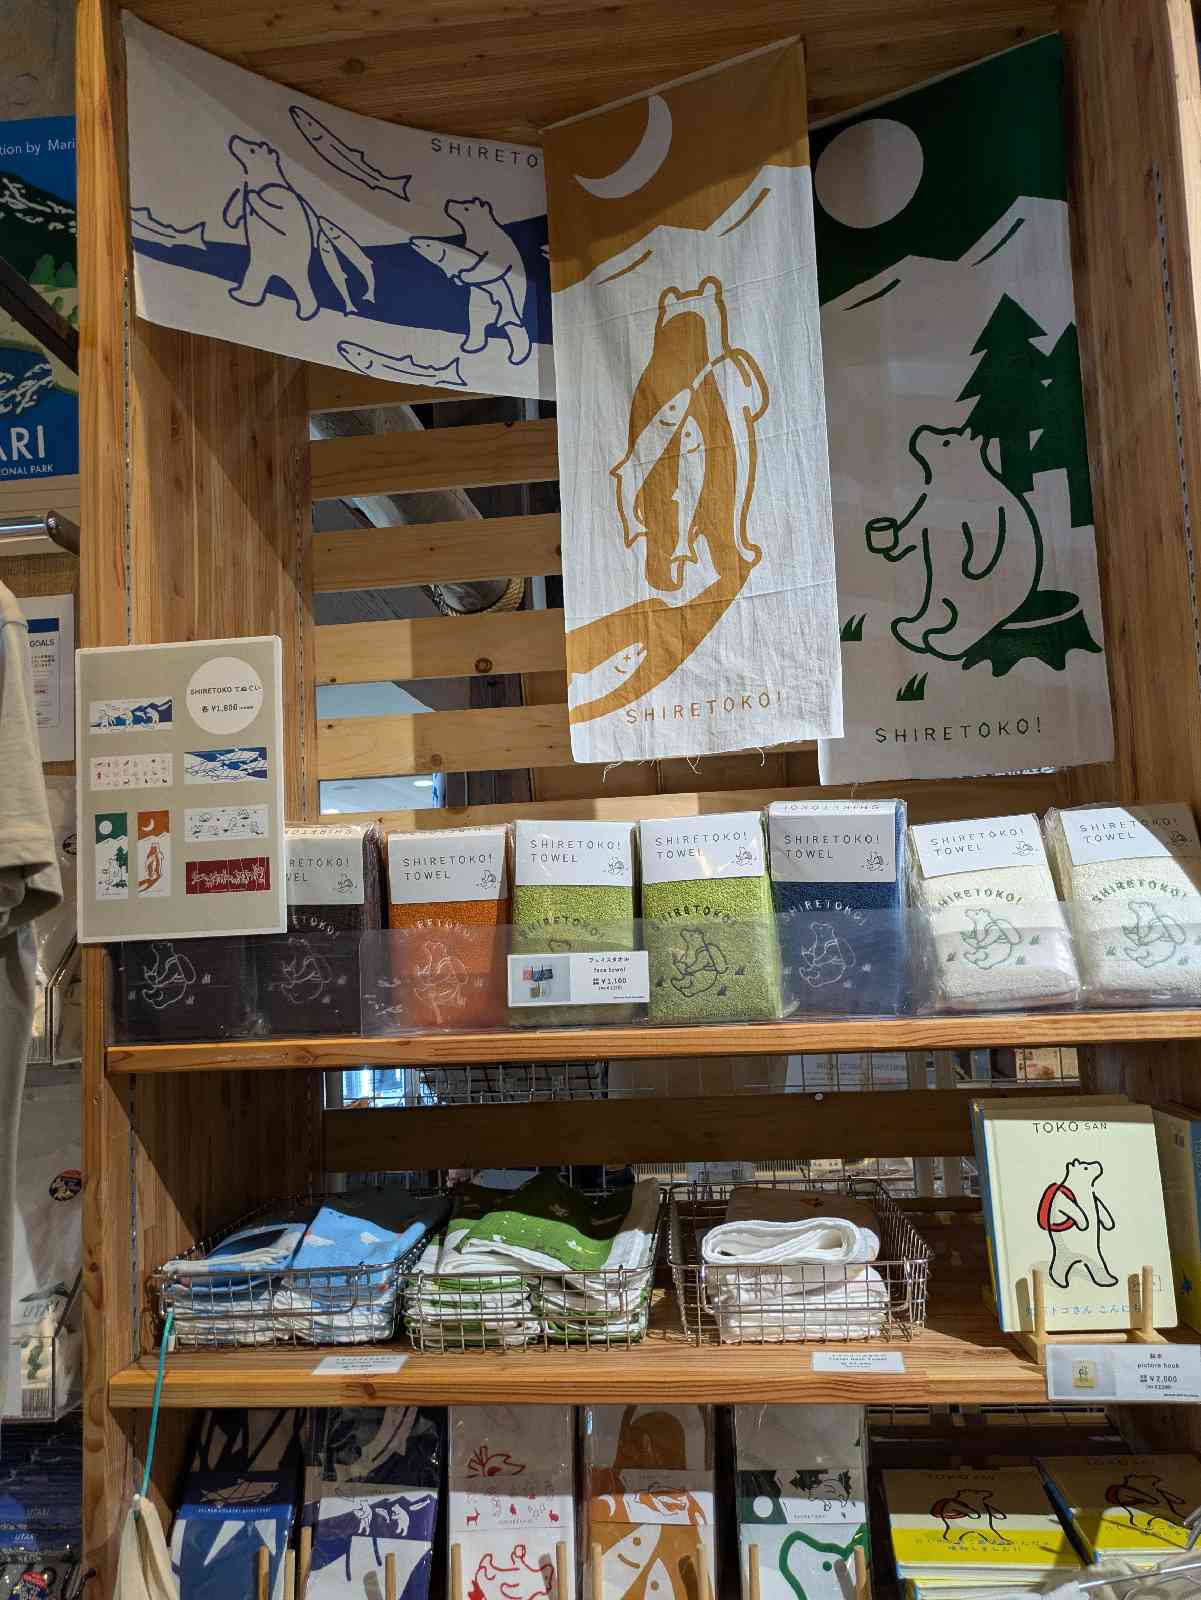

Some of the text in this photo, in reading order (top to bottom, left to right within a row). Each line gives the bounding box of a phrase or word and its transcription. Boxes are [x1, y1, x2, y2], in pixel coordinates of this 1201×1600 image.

[26, 140, 41, 156] by
[31, 464, 54, 472] PARK
[190, 686, 232, 696] SHIRETOKO
[626, 690, 782, 724] SHIRETOKO!
[874, 716, 1041, 743] SHIRETOKO!
[1079, 818, 1177, 832] SHIRETOKO!
[655, 831, 748, 847] SHIRETOKO!
[784, 834, 880, 845] SHIRETOKO!
[930, 828, 1024, 846] SHIRETOKO!
[1084, 832, 1137, 843] TOWEL
[530, 838, 621, 850] SHIRETOKO!
[935, 843, 981, 857] TOWEL
[402, 854, 493, 867] SHIRETOKO!
[531, 853, 578, 863] TOWEL
[785, 849, 833, 859] TOWEL
[404, 870, 451, 881] TOWEL
[1090, 878, 1187, 904] SHIRETOKO!
[1032, 1120, 1108, 1134] TOKO SAN
